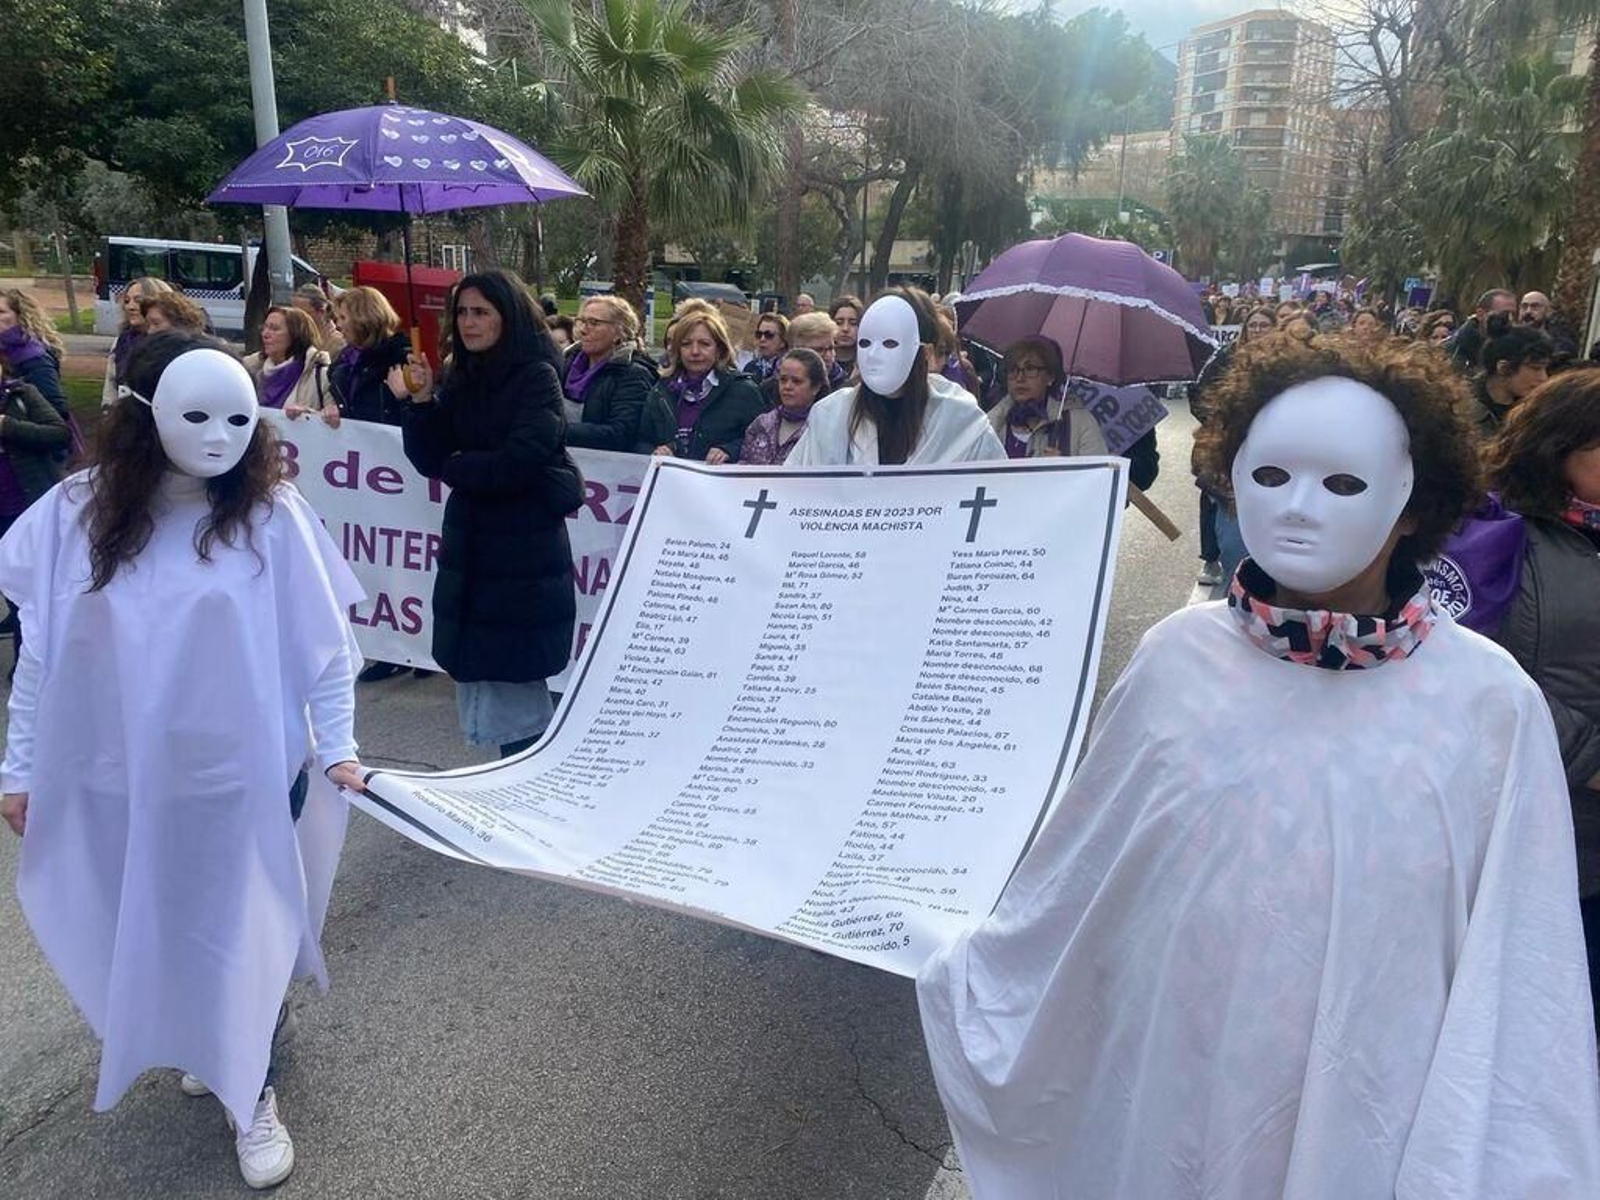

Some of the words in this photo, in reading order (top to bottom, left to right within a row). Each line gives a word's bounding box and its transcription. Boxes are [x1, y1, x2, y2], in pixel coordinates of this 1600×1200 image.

[304, 144, 339, 158] 016
[323, 450, 404, 494] de
[788, 508, 863, 518] ASESINADAS
[865, 508, 881, 517] EN
[884, 508, 915, 517] 2023
[917, 507, 942, 516] POR
[800, 522, 859, 531] VIOLENCIA
[861, 521, 923, 531] MACHISTA
[950, 562, 982, 570] Tatiana
[944, 584, 974, 592] Judith,
[953, 606, 990, 614] Carmen
[935, 617, 971, 626] Nombre
[972, 618, 1036, 627] desconocido,
[932, 628, 968, 636] Nombre
[970, 630, 1033, 638] desconocido,
[954, 651, 988, 660] Torres,
[922, 661, 960, 669] Nombre
[961, 663, 1026, 672] desconocido,
[919, 672, 957, 680] Nombre
[958, 674, 1023, 684] desconocido,
[912, 692, 950, 702] Catalina
[900, 726, 945, 735] Consuelo
[891, 748, 913, 756] Ana,
[876, 778, 916, 788] Nombre
[918, 781, 988, 794] desconocido,
[866, 799, 906, 808] Carmen
[831, 912, 884, 928] Gutiérrez,
[832, 928, 886, 940] Gutiérrez,
[889, 922, 904, 932] 70
[902, 936, 910, 946] 5
